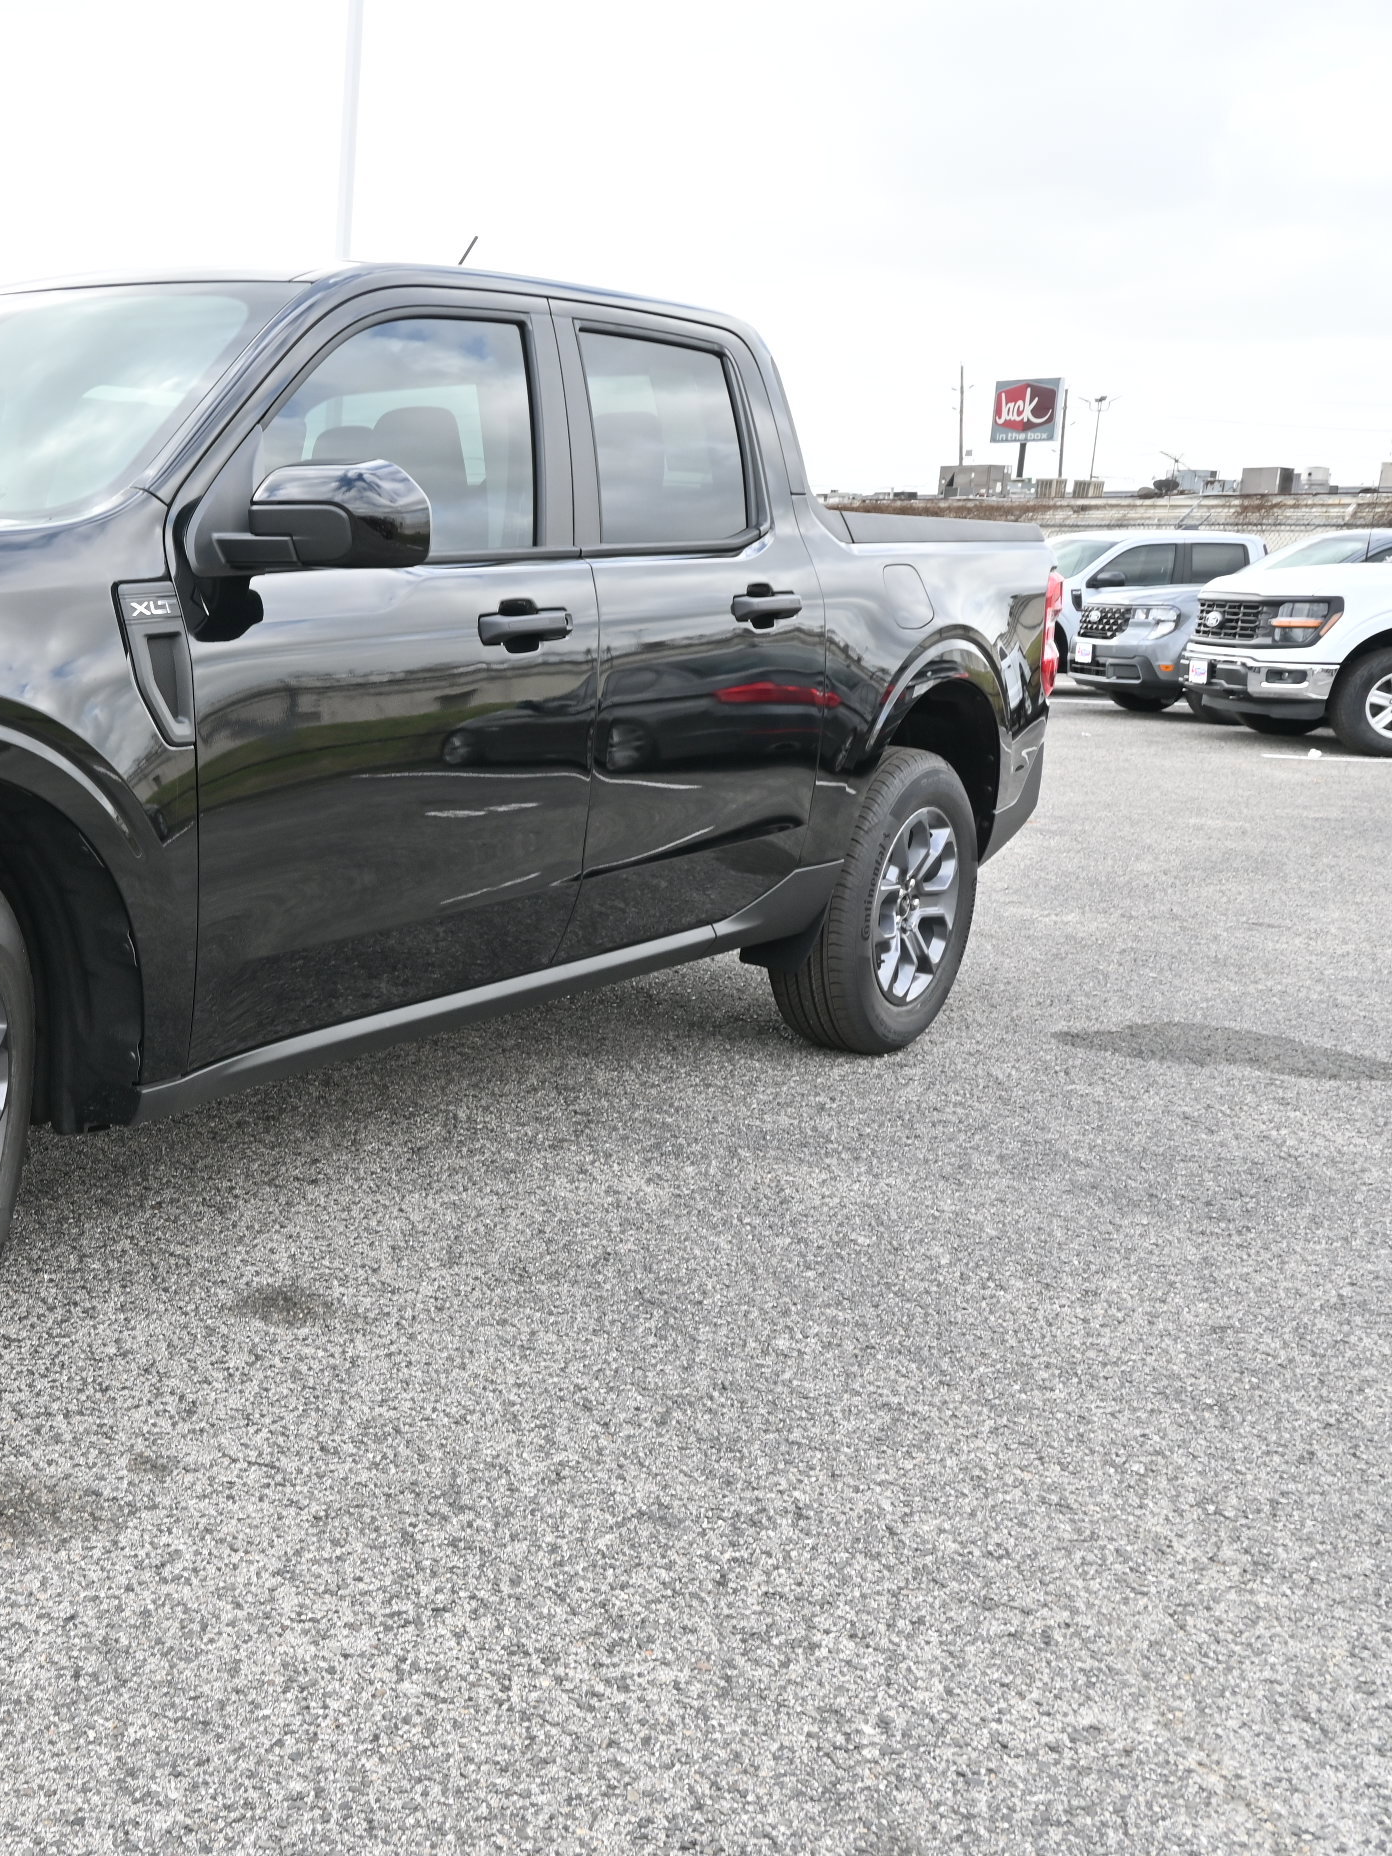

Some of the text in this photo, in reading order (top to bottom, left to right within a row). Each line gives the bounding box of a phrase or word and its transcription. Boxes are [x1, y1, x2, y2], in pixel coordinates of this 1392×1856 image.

[996, 387, 1052, 424] Jack
[996, 430, 1048, 441] in the box
[130, 600, 171, 616] XLT
[861, 843, 887, 940] Continental
